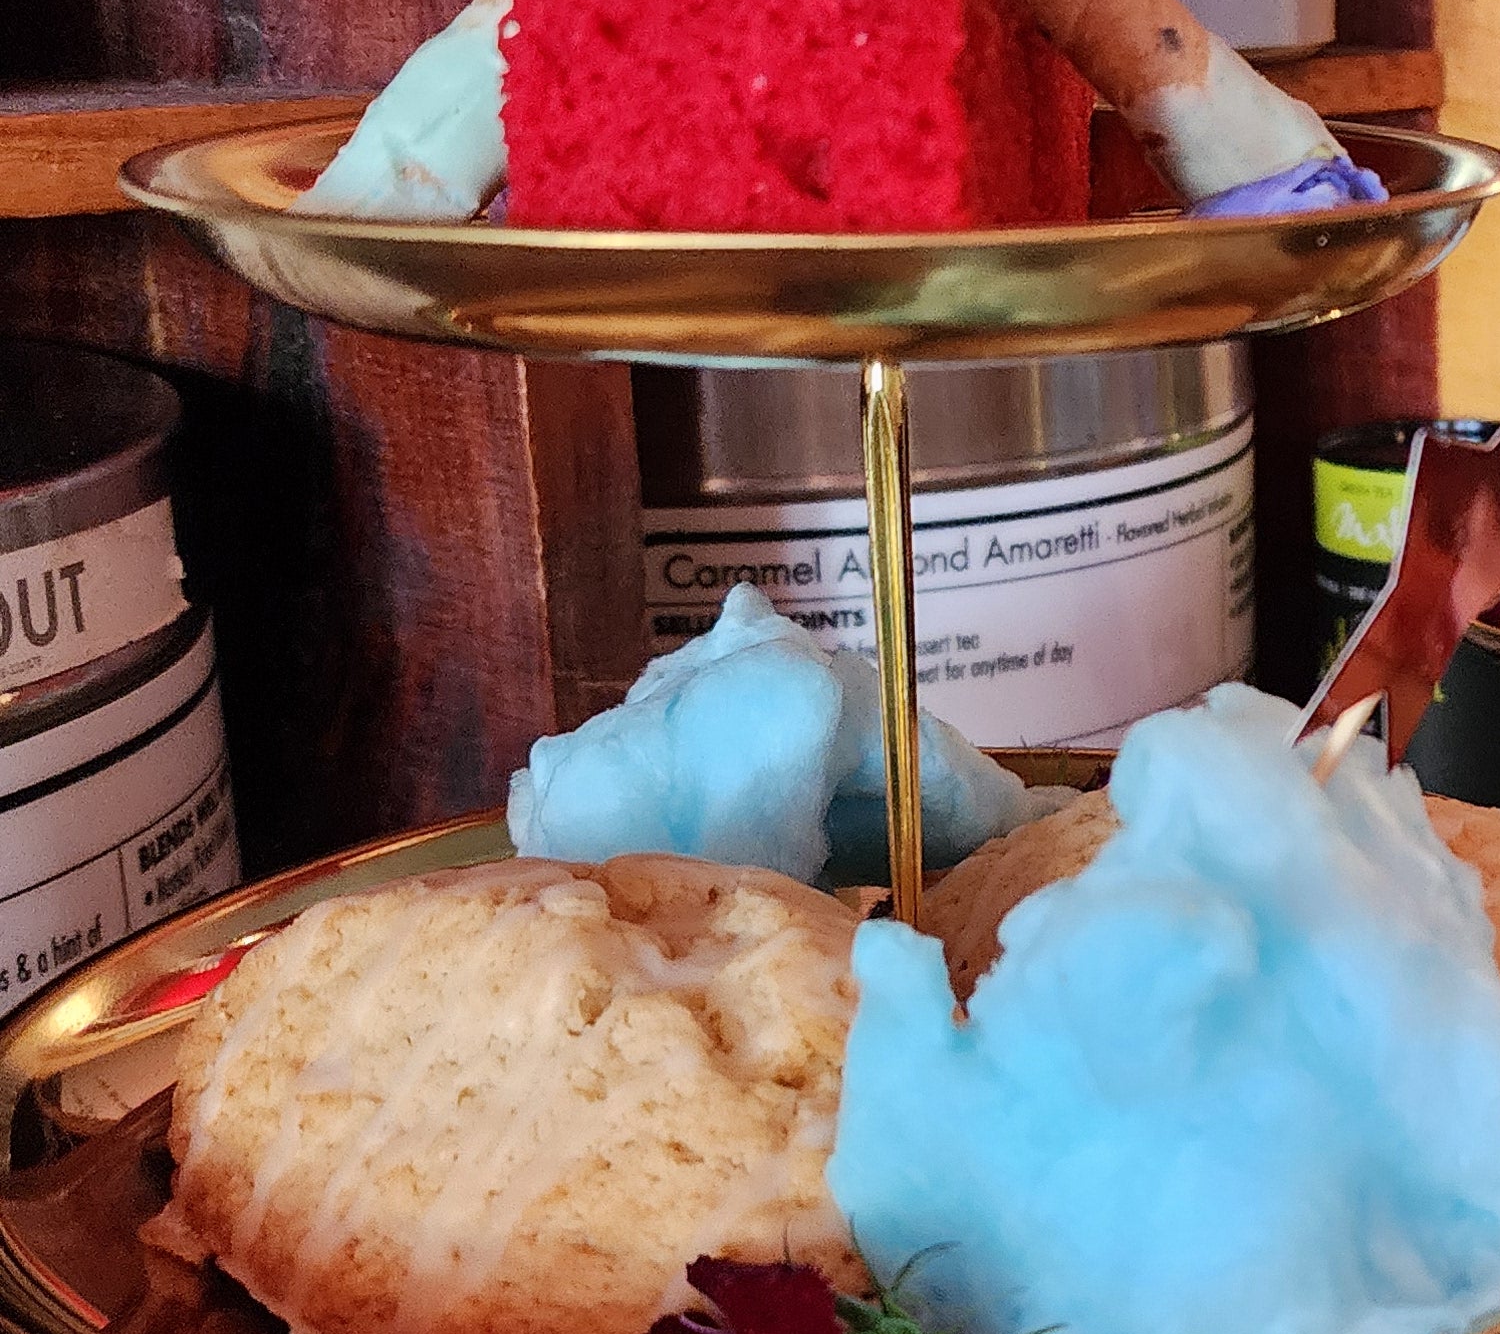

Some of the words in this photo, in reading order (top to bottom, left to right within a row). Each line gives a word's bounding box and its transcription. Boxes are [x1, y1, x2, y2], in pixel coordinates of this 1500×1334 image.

[664, 547, 822, 589] Caramel
[839, 535, 969, 582] Aond
[983, 520, 1100, 568] Amaretti
